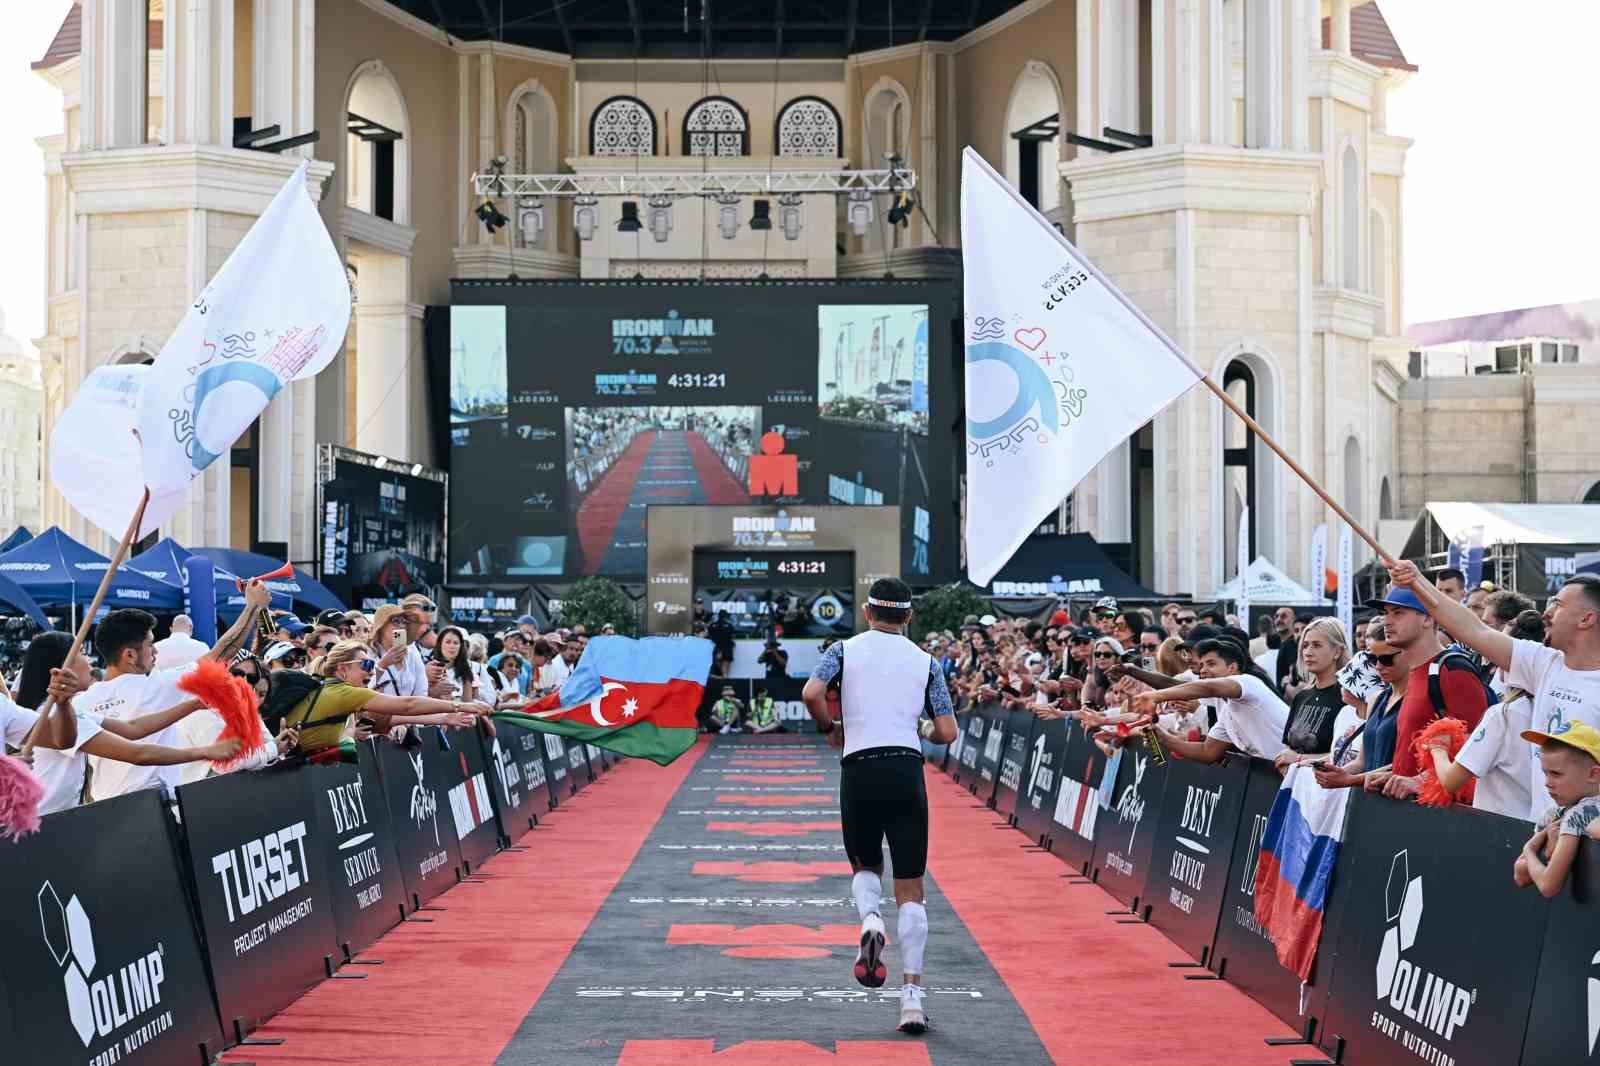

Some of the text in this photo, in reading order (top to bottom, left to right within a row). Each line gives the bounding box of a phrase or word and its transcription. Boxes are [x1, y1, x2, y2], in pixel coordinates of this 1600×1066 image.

[612, 313, 714, 336] IRONMAN
[613, 337, 652, 354] 70.3
[595, 371, 657, 384] IRONMAN
[667, 373, 726, 387] 4:31:21
[733, 512, 816, 531] IRONMAN
[322, 501, 338, 575] IRONMAN
[734, 531, 765, 546] 70.3
[335, 546, 348, 575] 70.3
[718, 559, 769, 570] IRONMAN
[777, 561, 826, 573] 4:31:21
[992, 577, 1102, 594] IRONMAN
[451, 593, 517, 610] IRONMAN
[820, 605, 834, 616] 10
[452, 609, 476, 621] 70.3
[327, 776, 368, 834] BEST
[1180, 785, 1219, 838] BEST
[211, 821, 309, 923] TURSET
[343, 847, 381, 887] SERVICE
[1170, 850, 1206, 890] SERVICE
[234, 897, 313, 957] PROJECT MANAGEMENT
[124, 1010, 173, 1055] NUTRITION
[1371, 1011, 1401, 1041] SPORT
